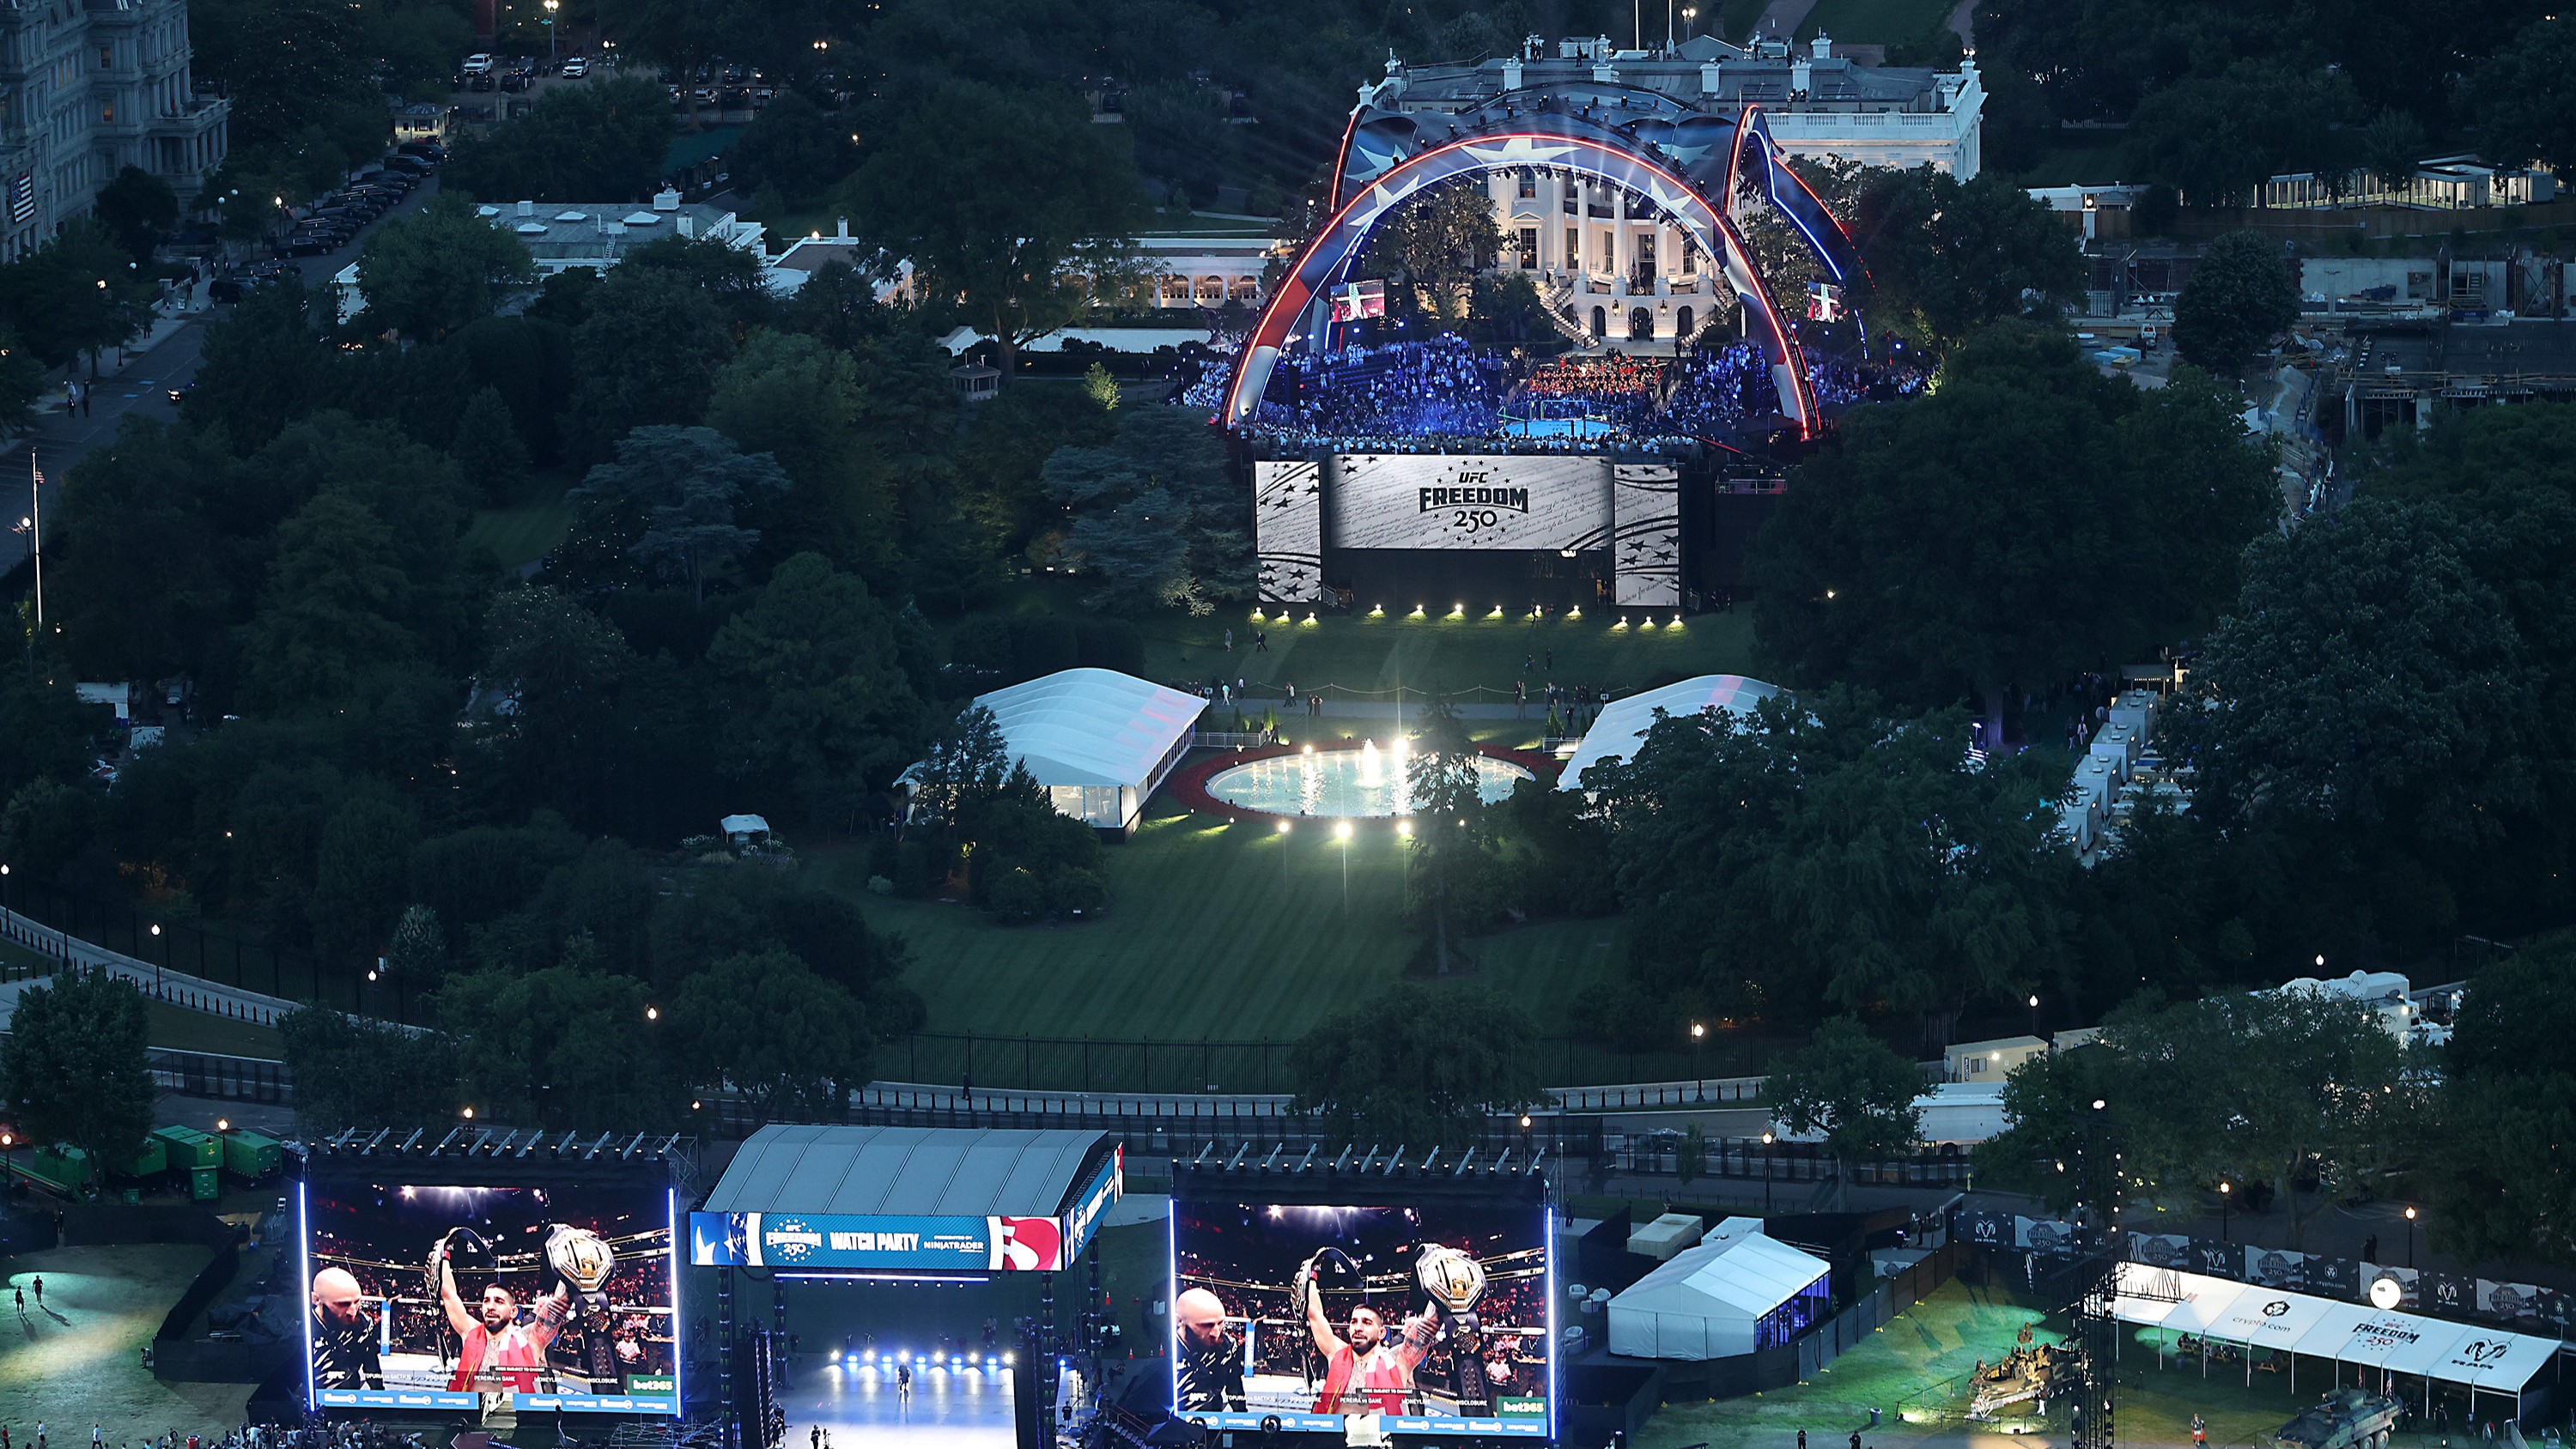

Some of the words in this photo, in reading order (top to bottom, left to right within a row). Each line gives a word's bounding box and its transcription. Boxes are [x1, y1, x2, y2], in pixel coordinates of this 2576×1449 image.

[1459, 472, 1488, 483] UFC
[1419, 488, 1528, 514] FREEDOM
[1453, 510, 1498, 534] 250
[786, 1224, 802, 1233] UFC
[766, 1232, 823, 1247] FREEDOM
[829, 1232, 875, 1251] WATCH
[877, 1233, 920, 1251] PARTY
[923, 1241, 984, 1250] NINJATRADER
[783, 1244, 807, 1257] 250
[2317, 1280, 2347, 1289] crypto.com
[2233, 1315, 2291, 1333] crypto.com
[2352, 1323, 2421, 1345] FREEDOM
[2366, 1336, 2394, 1347] 250
[2451, 1359, 2494, 1370] RAM
[633, 1379, 673, 1391] bet365
[1503, 1401, 1544, 1413] bet365
